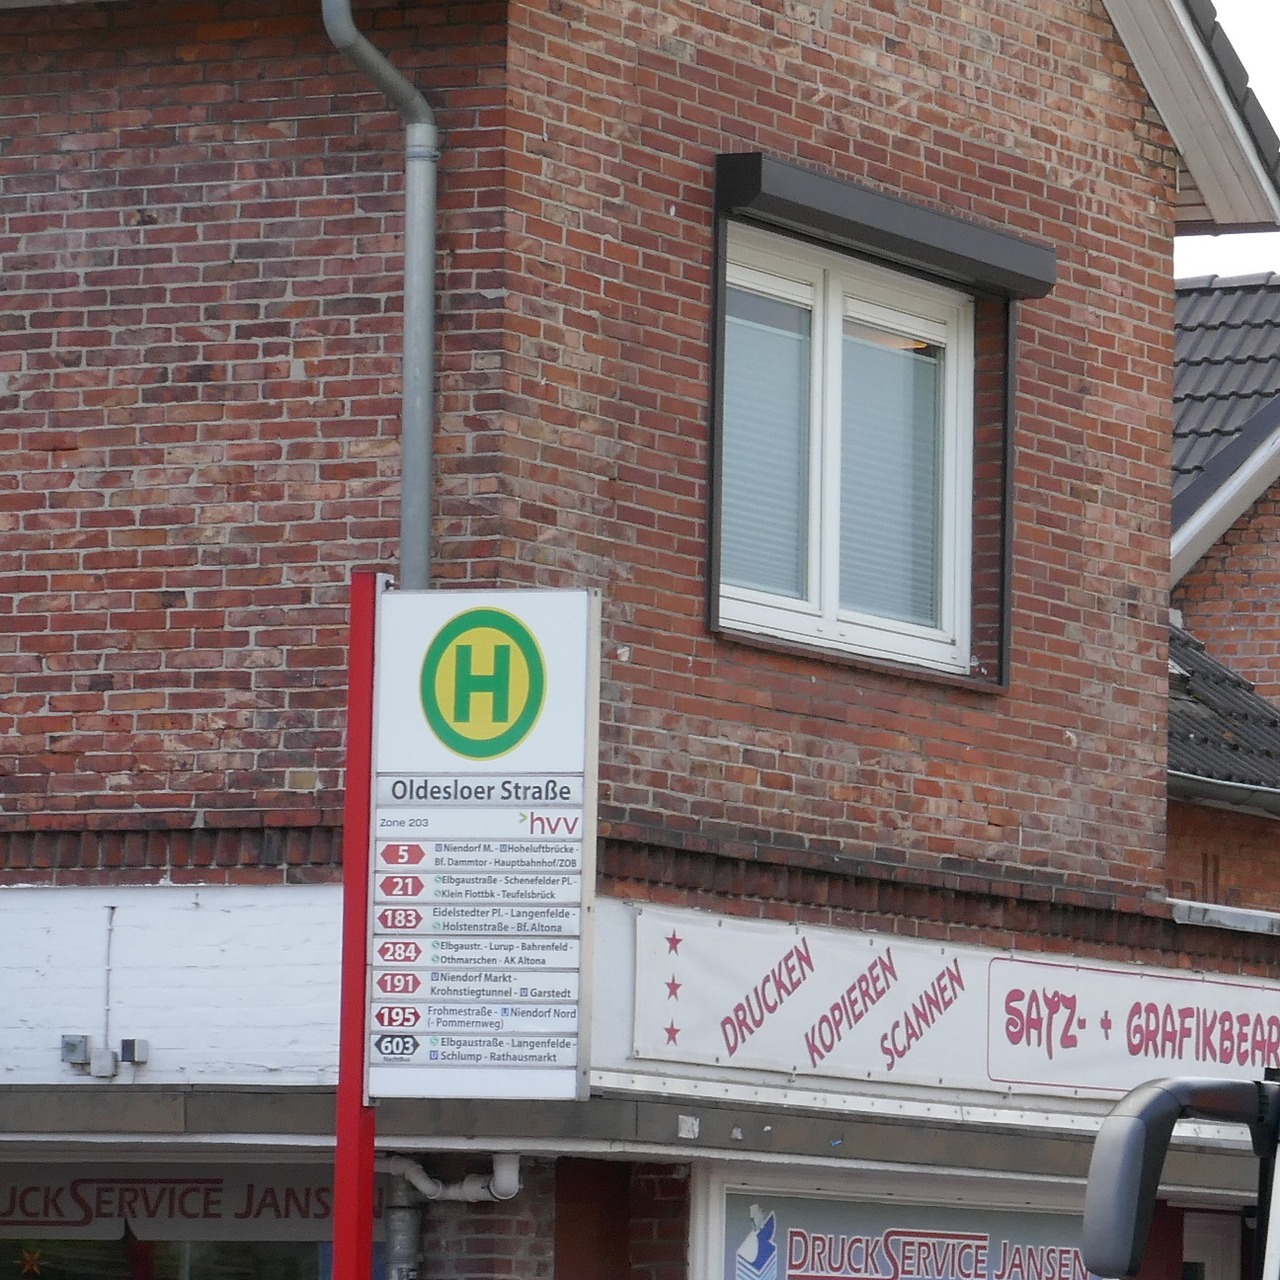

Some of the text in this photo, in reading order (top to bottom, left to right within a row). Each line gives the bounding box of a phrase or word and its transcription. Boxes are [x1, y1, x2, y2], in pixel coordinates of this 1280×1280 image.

[392, 779, 571, 801] Oldesloer Straße
[380, 818, 429, 828] Zone 203
[530, 811, 579, 835] hvv
[397, 846, 409, 863] 5
[443, 843, 481, 853] Niendorf
[435, 855, 577, 867] Bf. Dammtor Hauptbahnhof/ZOB
[392, 878, 414, 896] 21
[442, 876, 498, 886] Elbgaustraße
[503, 876, 560, 886] Schenefelder
[441, 890, 556, 900] Klein Flottbk Teufelsbrück
[385, 910, 417, 927] 183
[432, 908, 490, 918] Eidelstedter
[511, 909, 570, 920] Langenfelde
[442, 923, 509, 932] Holstenstraße
[532, 923, 562, 933] Altona
[384, 943, 417, 961] 284
[440, 942, 568, 953] Elbgaustr. Lurup Bahrenfeld
[440, 956, 546, 965] Othmarschen AK Altona
[384, 975, 415, 992] 191
[440, 973, 482, 982] Niendorf
[484, 973, 512, 982] Markt
[430, 986, 512, 998] Krohnstiegtunnel
[530, 988, 572, 998] Garstedt
[720, 936, 815, 1057] DRUCKEN
[428, 1006, 577, 1019] Frohmestraße Niendorf Nord
[804, 946, 898, 1068] KOPIEREN
[380, 1008, 417, 1027] 195
[880, 957, 965, 1071] SCANNEN
[436, 1018, 504, 1031] Pommernweg)
[381, 1038, 415, 1055] 603
[441, 1038, 504, 1049] Elbgaustraße
[511, 1039, 572, 1050] Langenfelde
[441, 1051, 483, 1063] Schlump
[489, 1052, 557, 1062] Rathausmarkt
